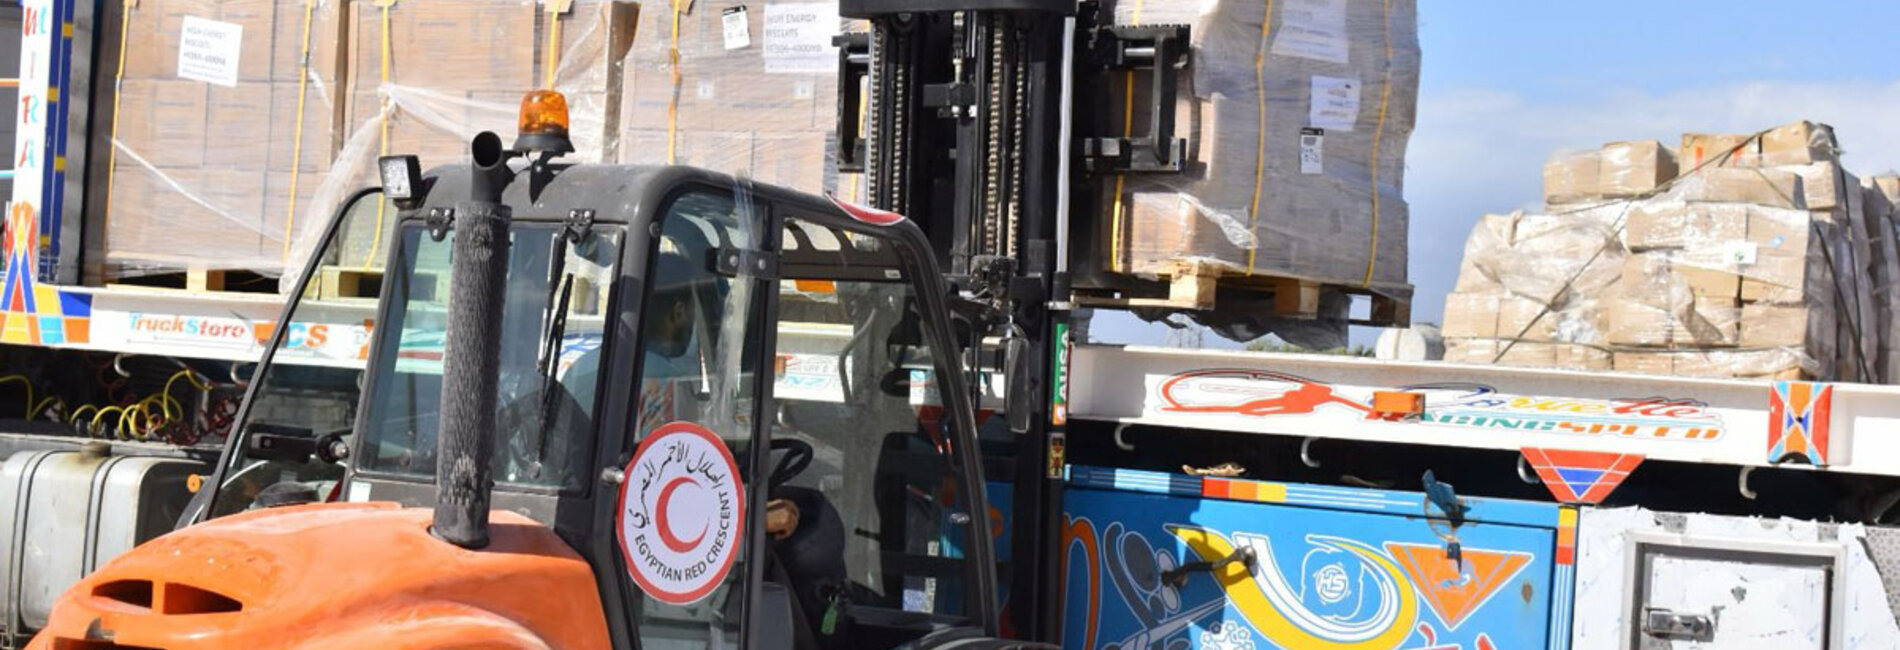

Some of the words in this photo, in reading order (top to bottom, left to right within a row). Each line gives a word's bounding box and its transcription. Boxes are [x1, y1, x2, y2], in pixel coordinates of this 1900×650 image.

[786, 14, 816, 24] ENERGY
[129, 313, 245, 338] TruckStore
[1059, 331, 1069, 400] AUSA
[634, 534, 681, 581] EGYPTIAN
[685, 561, 707, 580] RED
[706, 491, 731, 564] CRESCENT
